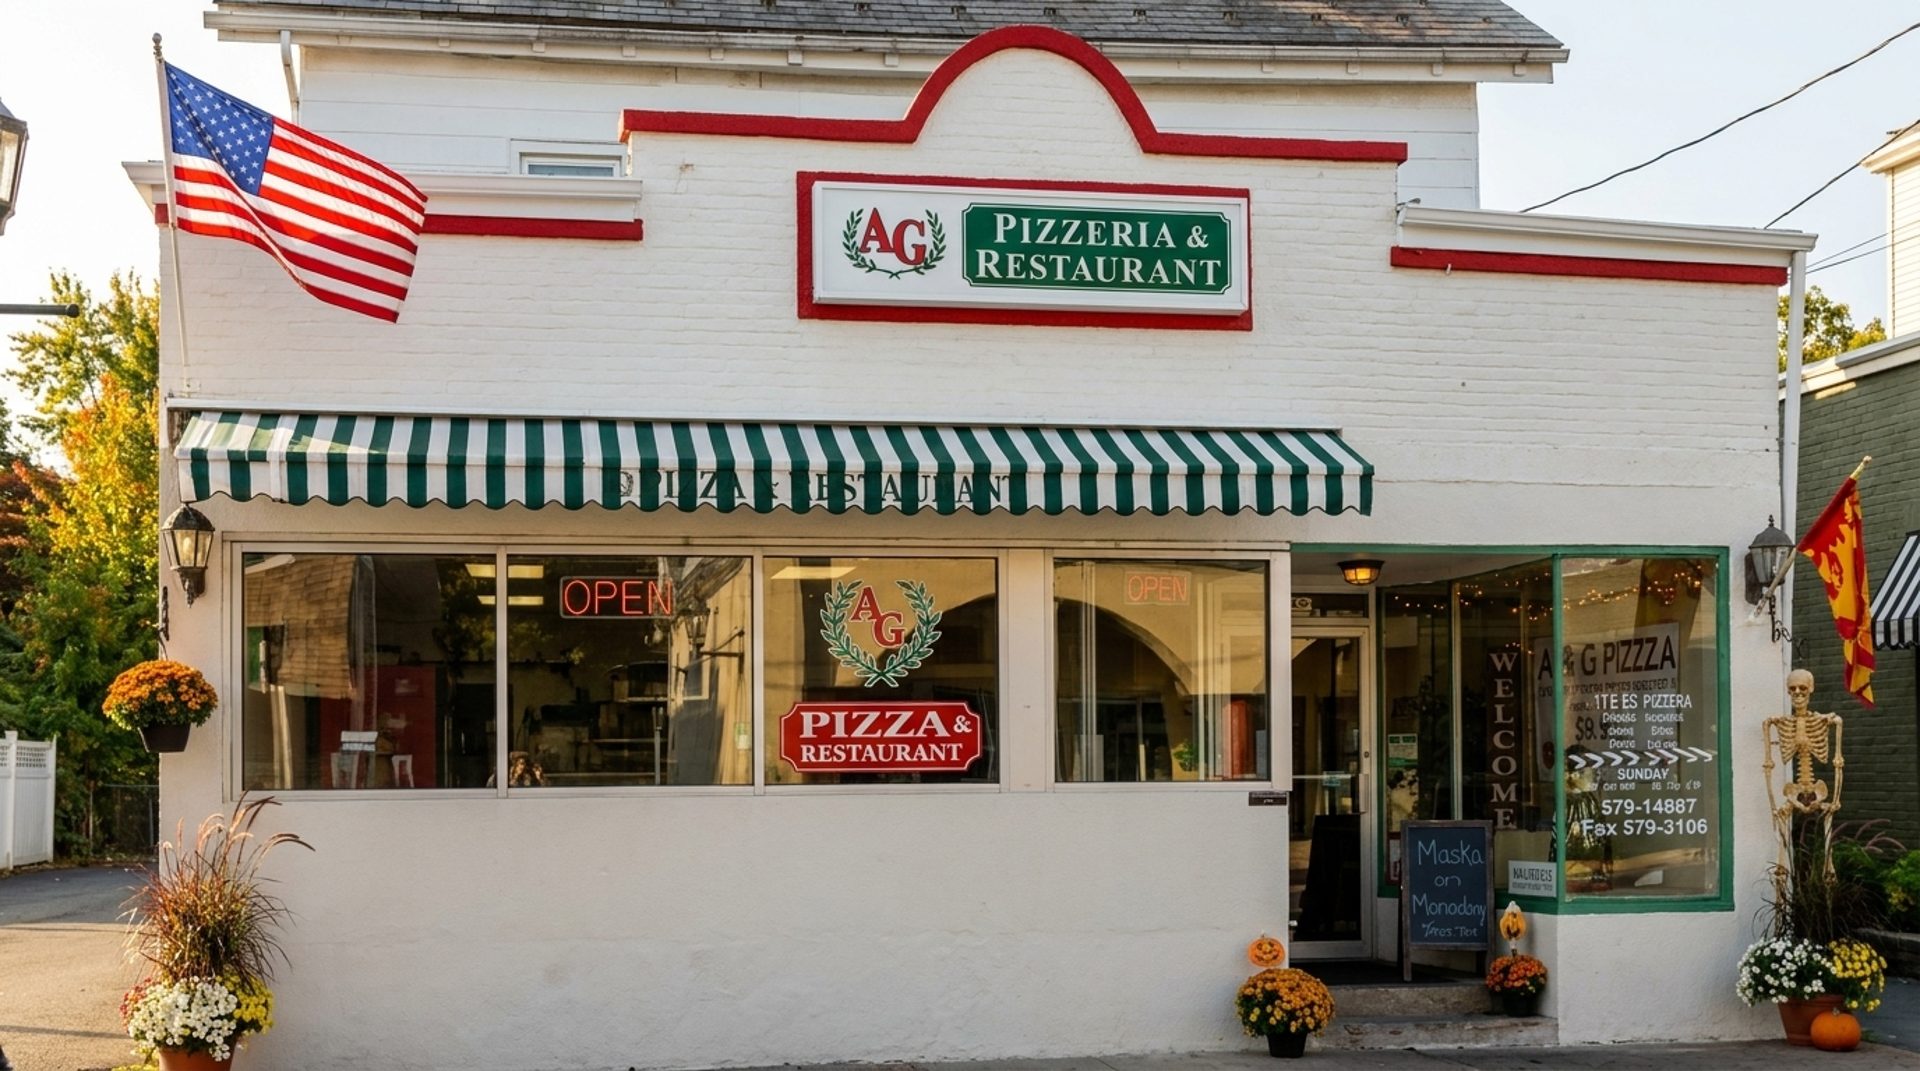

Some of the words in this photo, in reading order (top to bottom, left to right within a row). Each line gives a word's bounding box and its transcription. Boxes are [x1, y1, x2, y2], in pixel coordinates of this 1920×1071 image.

[1186, 225, 1209, 249] &
[564, 580, 673, 615] OPEN
[1128, 575, 1187, 601] OPEN
[1581, 643, 1597, 676] G
[799, 711, 950, 739] PIZZA
[953, 714, 972, 733] &
[801, 743, 963, 763] RESTAURANT
[1489, 652, 1518, 829] WELCOME
[1617, 768, 1670, 780] SUNDAY
[1581, 819, 1617, 836] Fax
